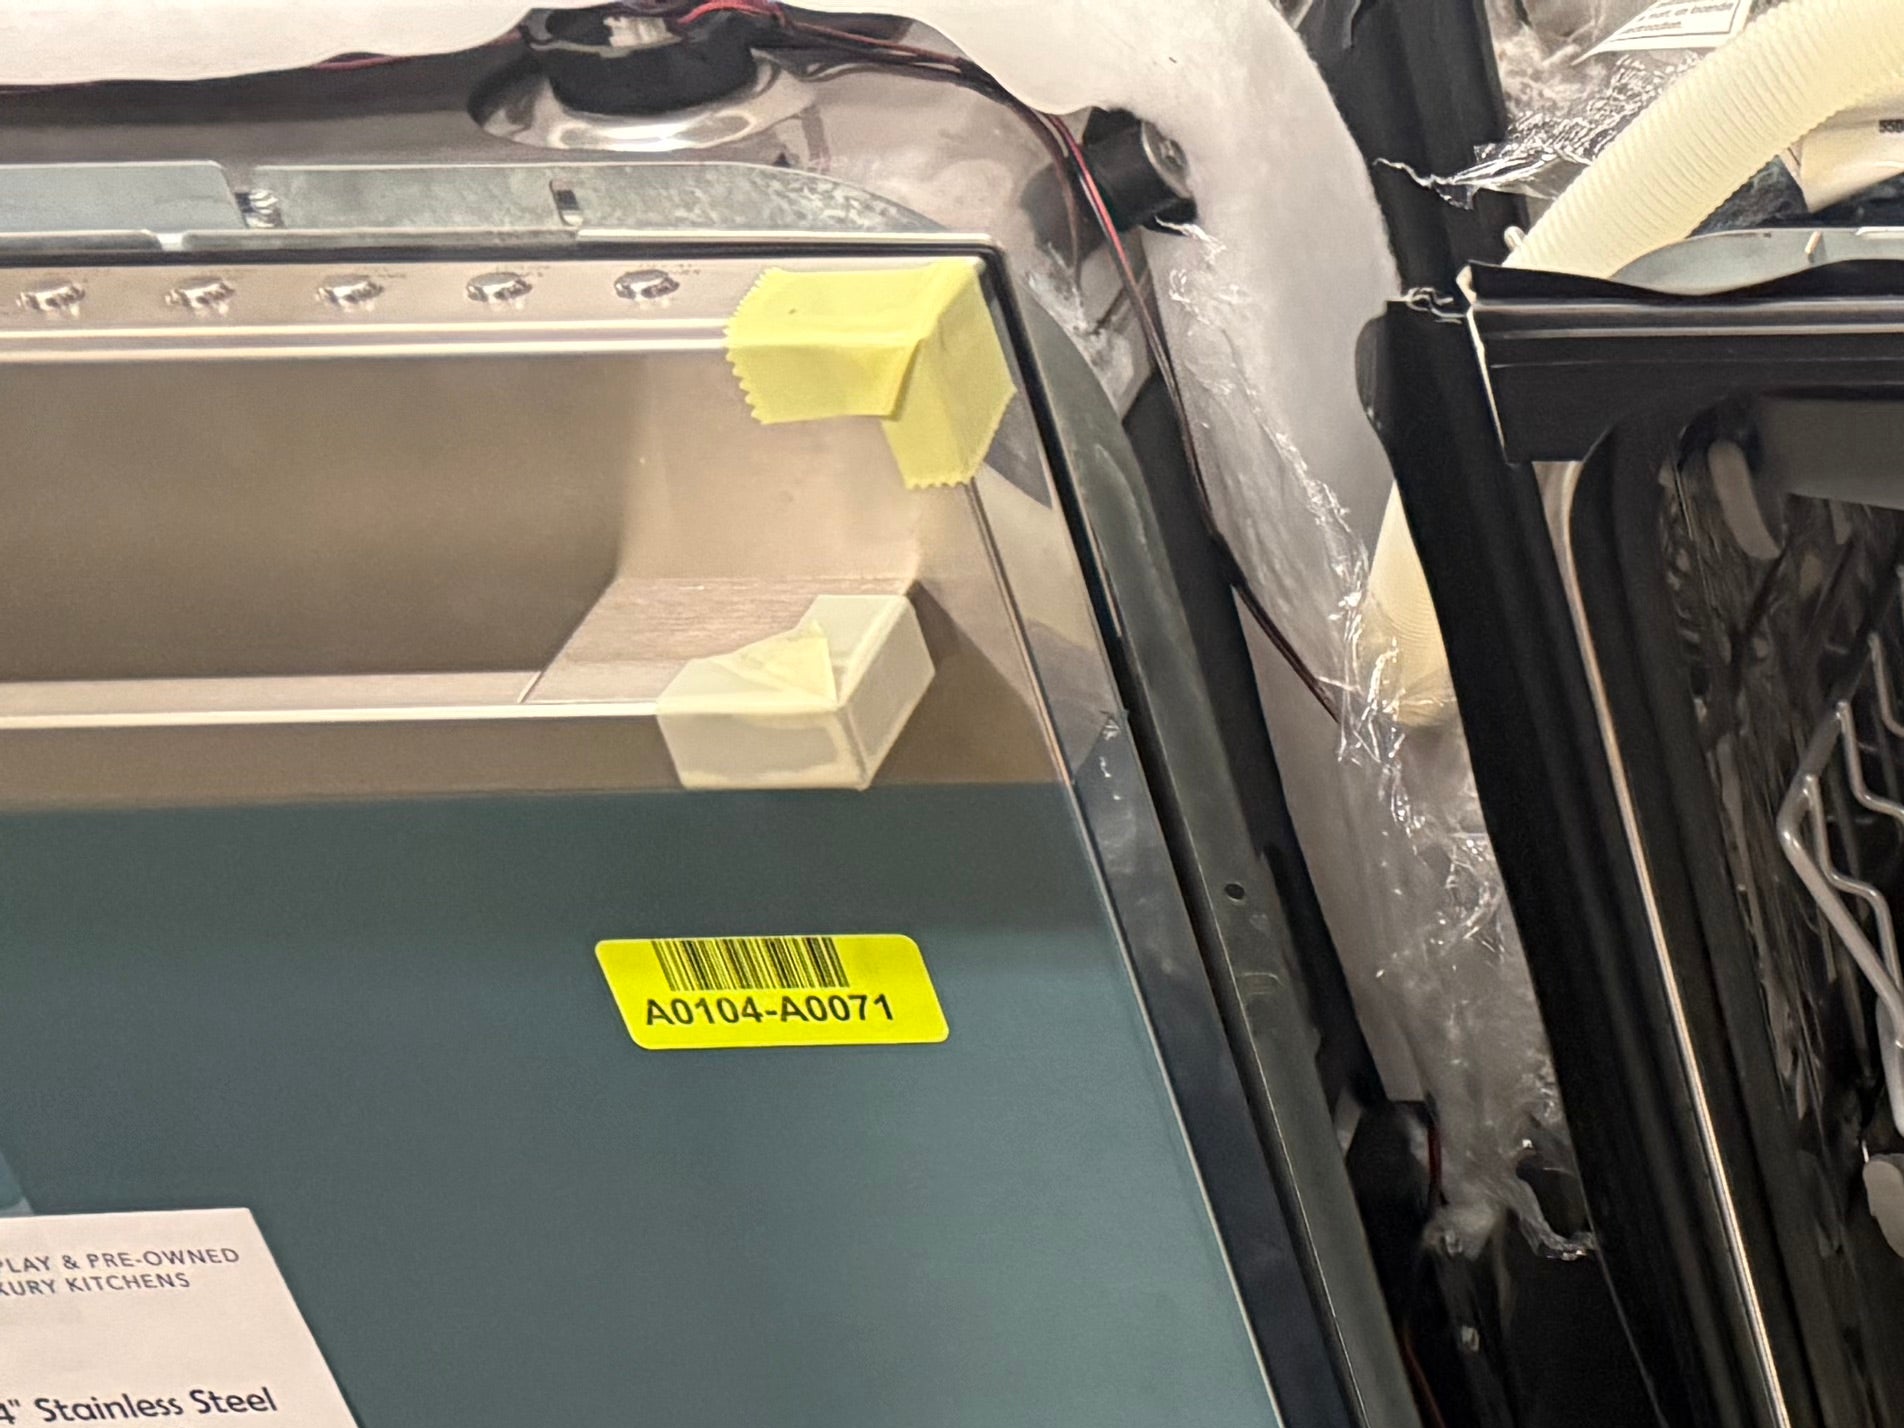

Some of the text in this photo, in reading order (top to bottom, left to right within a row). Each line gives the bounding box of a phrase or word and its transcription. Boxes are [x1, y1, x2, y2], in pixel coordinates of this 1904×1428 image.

[646, 993, 894, 1027] A0104-A0071
[62, 1254, 80, 1271] &
[86, 1247, 240, 1269] PRE-OWNED
[65, 1272, 191, 1293] KITCHENS
[34, 1393, 184, 1422] Stainless
[189, 1386, 278, 1414] Steel
